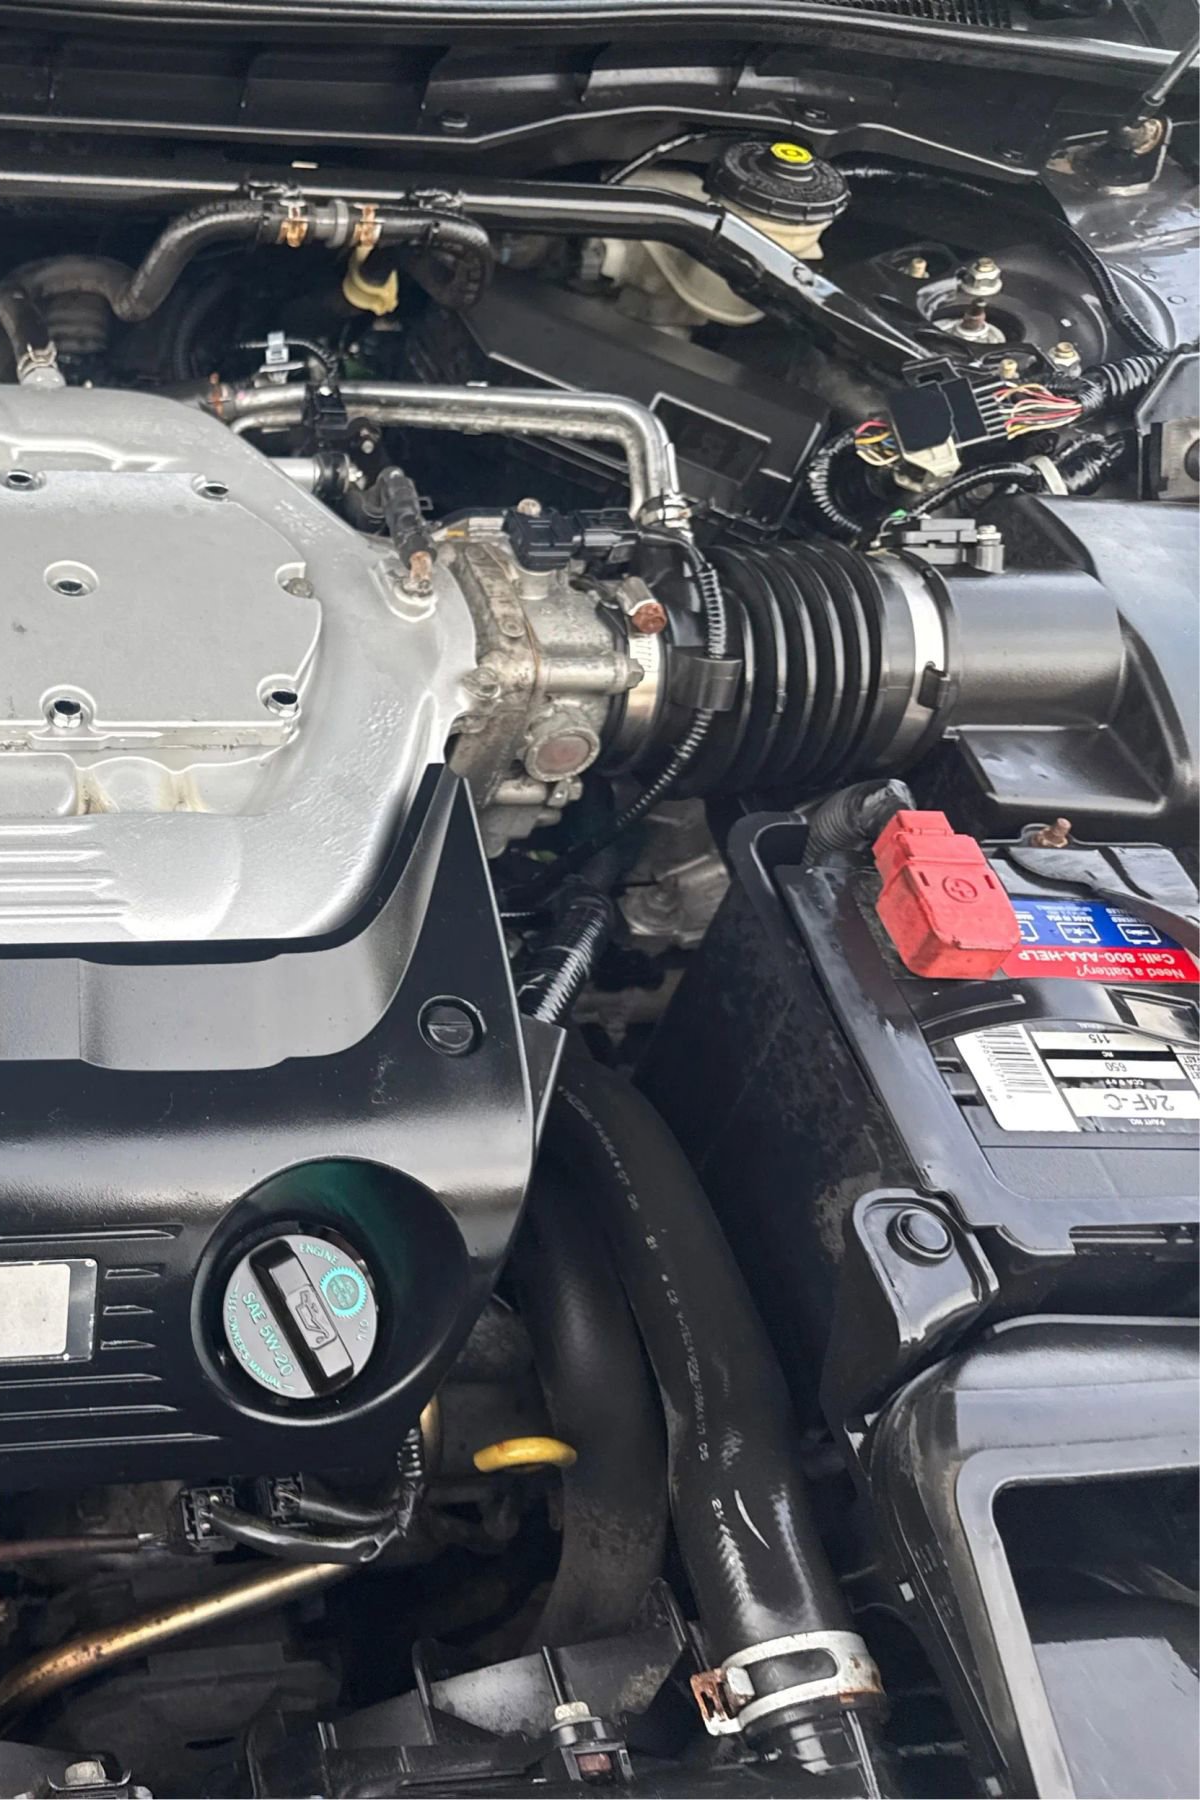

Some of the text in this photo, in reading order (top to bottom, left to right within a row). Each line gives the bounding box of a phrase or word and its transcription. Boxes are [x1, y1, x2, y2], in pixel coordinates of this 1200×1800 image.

[1017, 948, 1175, 964] Call: 800-AAA-HELP
[1076, 964, 1185, 979] Need a battery?
[1088, 1033, 1111, 1044] 115
[1104, 1062, 1127, 1073] 650
[1103, 1093, 1174, 1112] 24F-C
[299, 1242, 339, 1265] ENGINE
[242, 1291, 295, 1377] SAE 5W-20
[356, 1318, 370, 1343] OIL
[226, 1314, 249, 1364] OWNER'S
[247, 1360, 283, 1391] MANUAL
